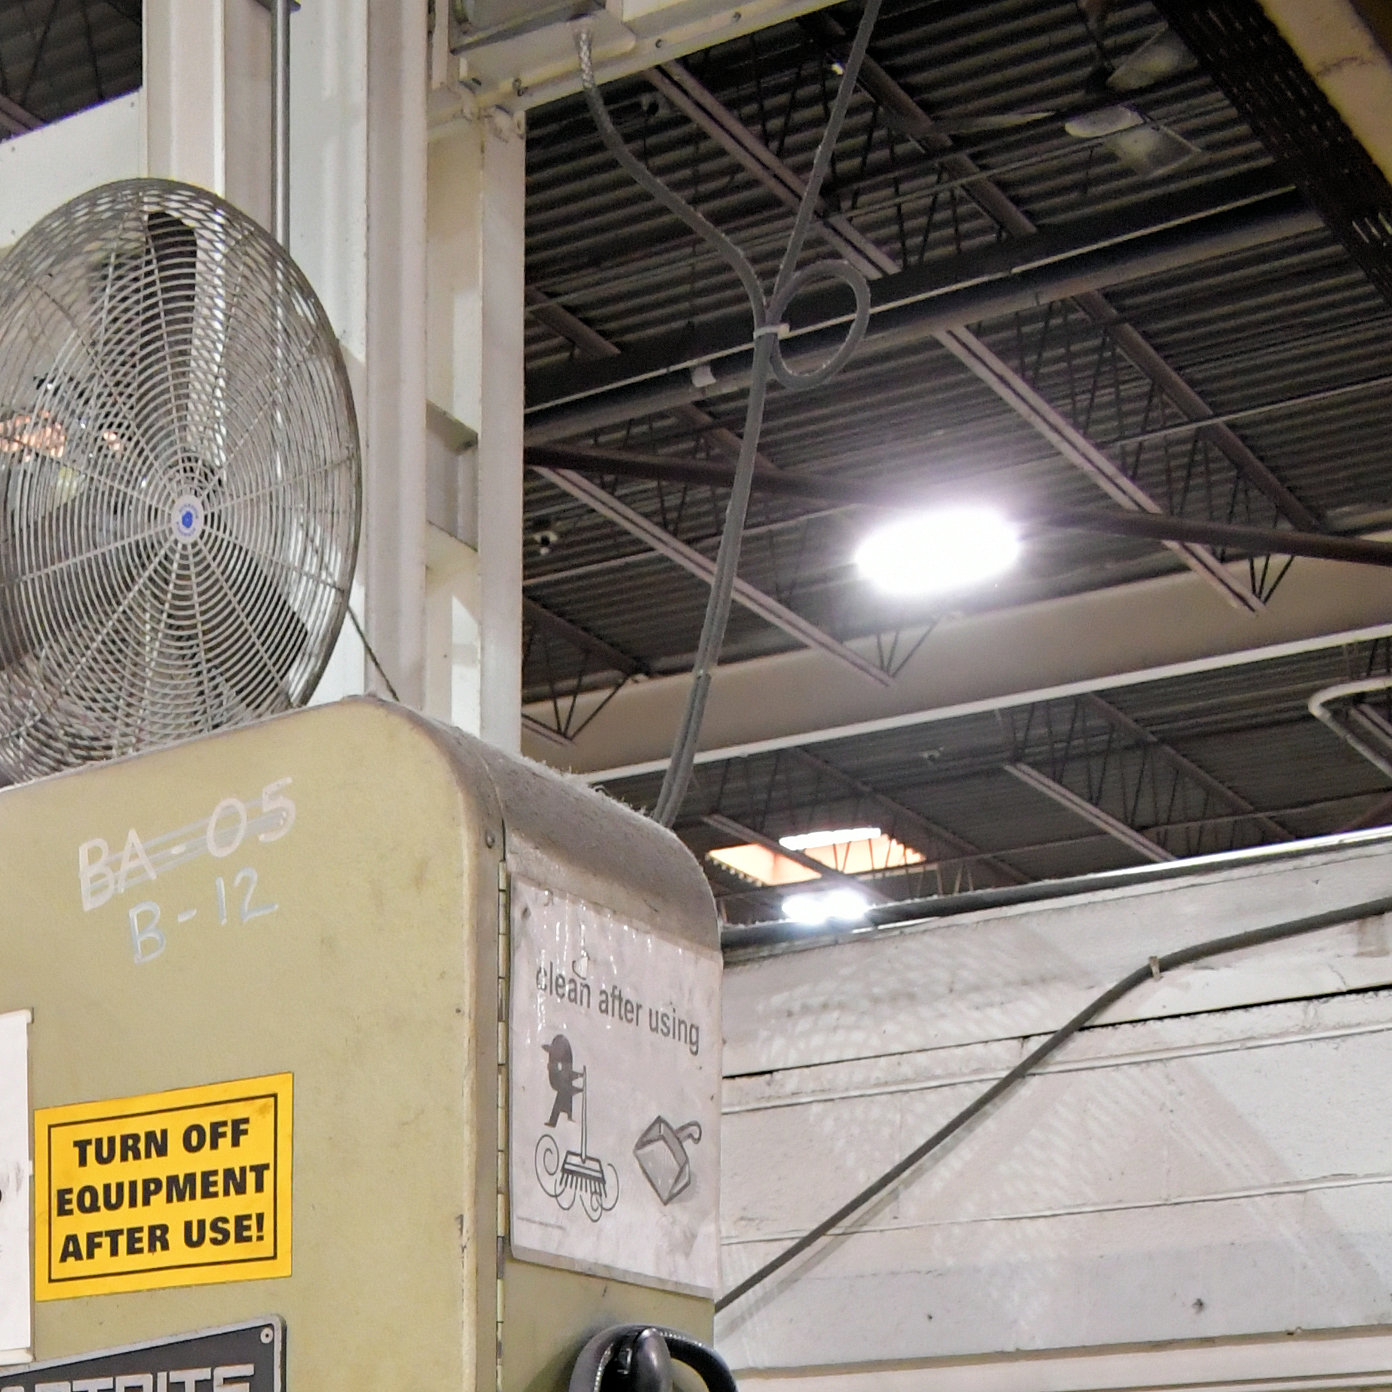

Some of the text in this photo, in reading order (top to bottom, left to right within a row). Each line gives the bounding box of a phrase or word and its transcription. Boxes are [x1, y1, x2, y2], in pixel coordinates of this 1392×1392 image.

[129, 867, 278, 965] B-12
[536, 961, 700, 1056] clean after using
[73, 1117, 250, 1168] TURN OFF
[56, 1163, 270, 1217] EQUIPMENT
[59, 1212, 265, 1263] AFTER USE!
